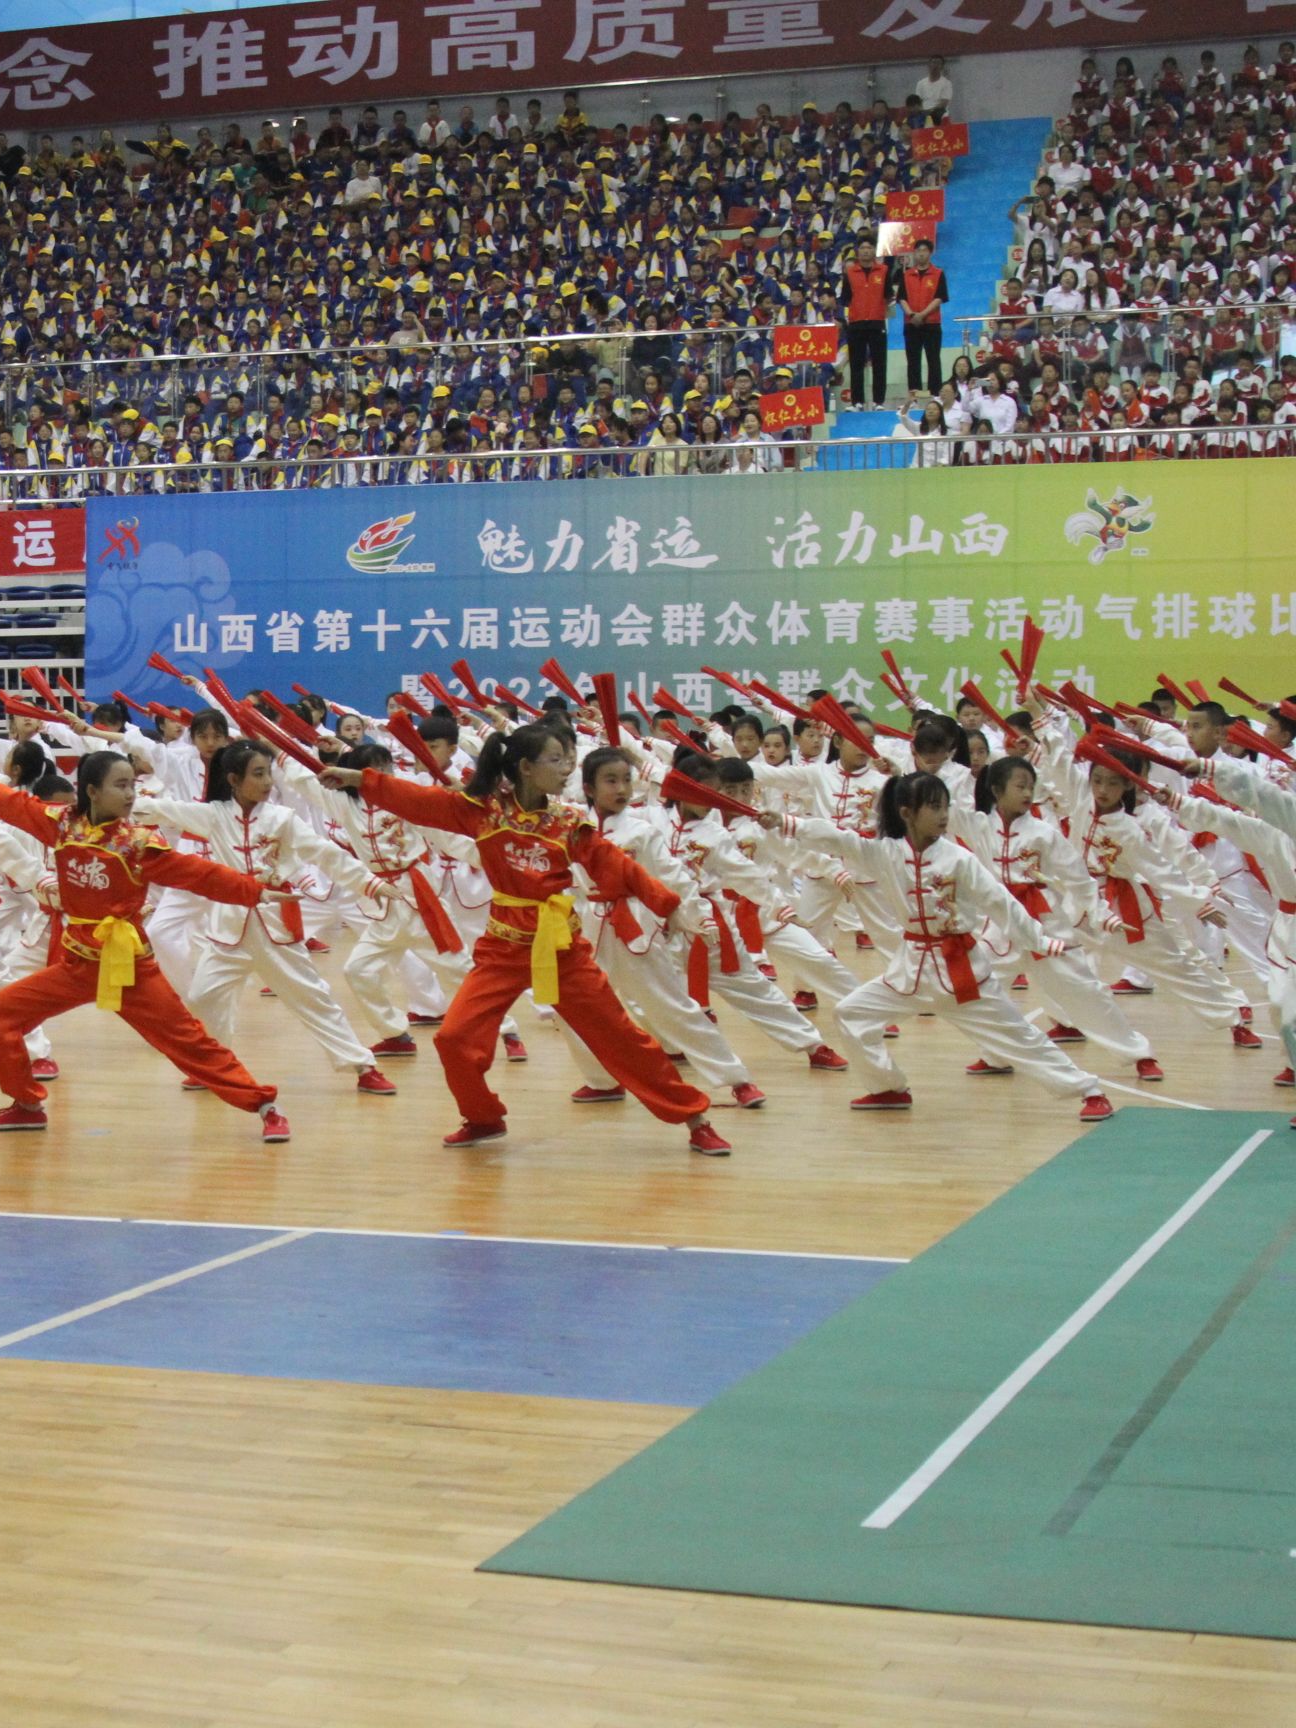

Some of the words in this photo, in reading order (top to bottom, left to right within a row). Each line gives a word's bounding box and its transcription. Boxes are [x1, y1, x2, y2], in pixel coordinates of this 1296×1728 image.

[477, 515, 718, 575] 魅力省运
[766, 510, 1009, 569] 活力山西
